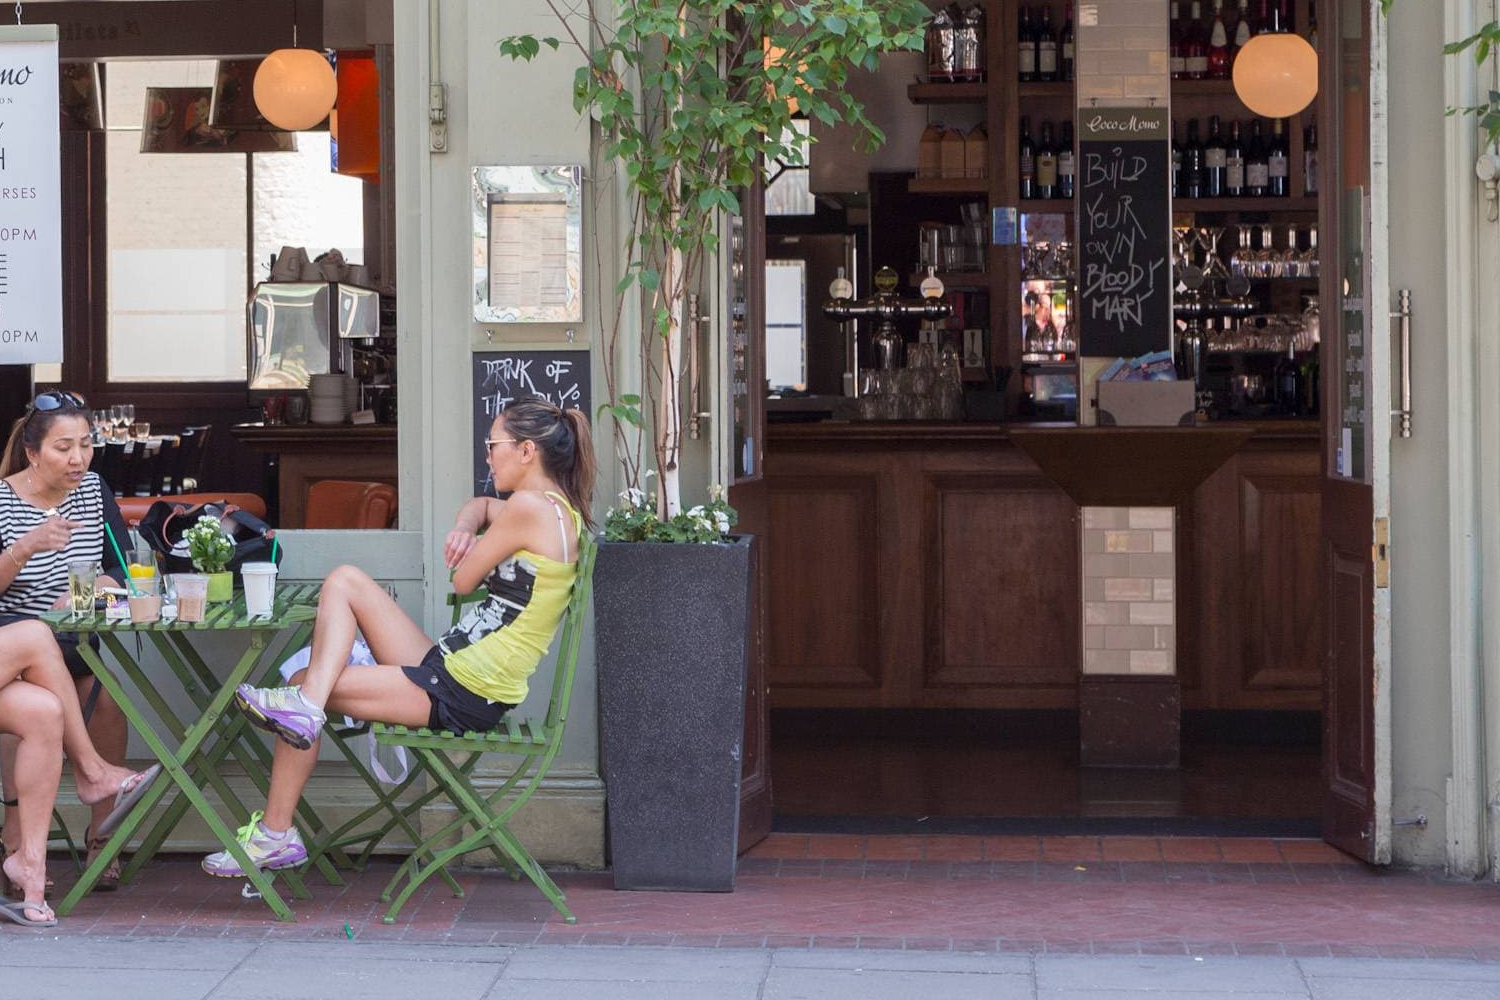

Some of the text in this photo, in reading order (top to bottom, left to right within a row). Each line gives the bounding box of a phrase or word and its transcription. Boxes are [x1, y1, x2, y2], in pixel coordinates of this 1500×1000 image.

[1086, 114, 1160, 132] Coco Momo
[1086, 192, 1147, 240] YOUR
[1092, 288, 1155, 333] MARY
[545, 360, 573, 384] OF
